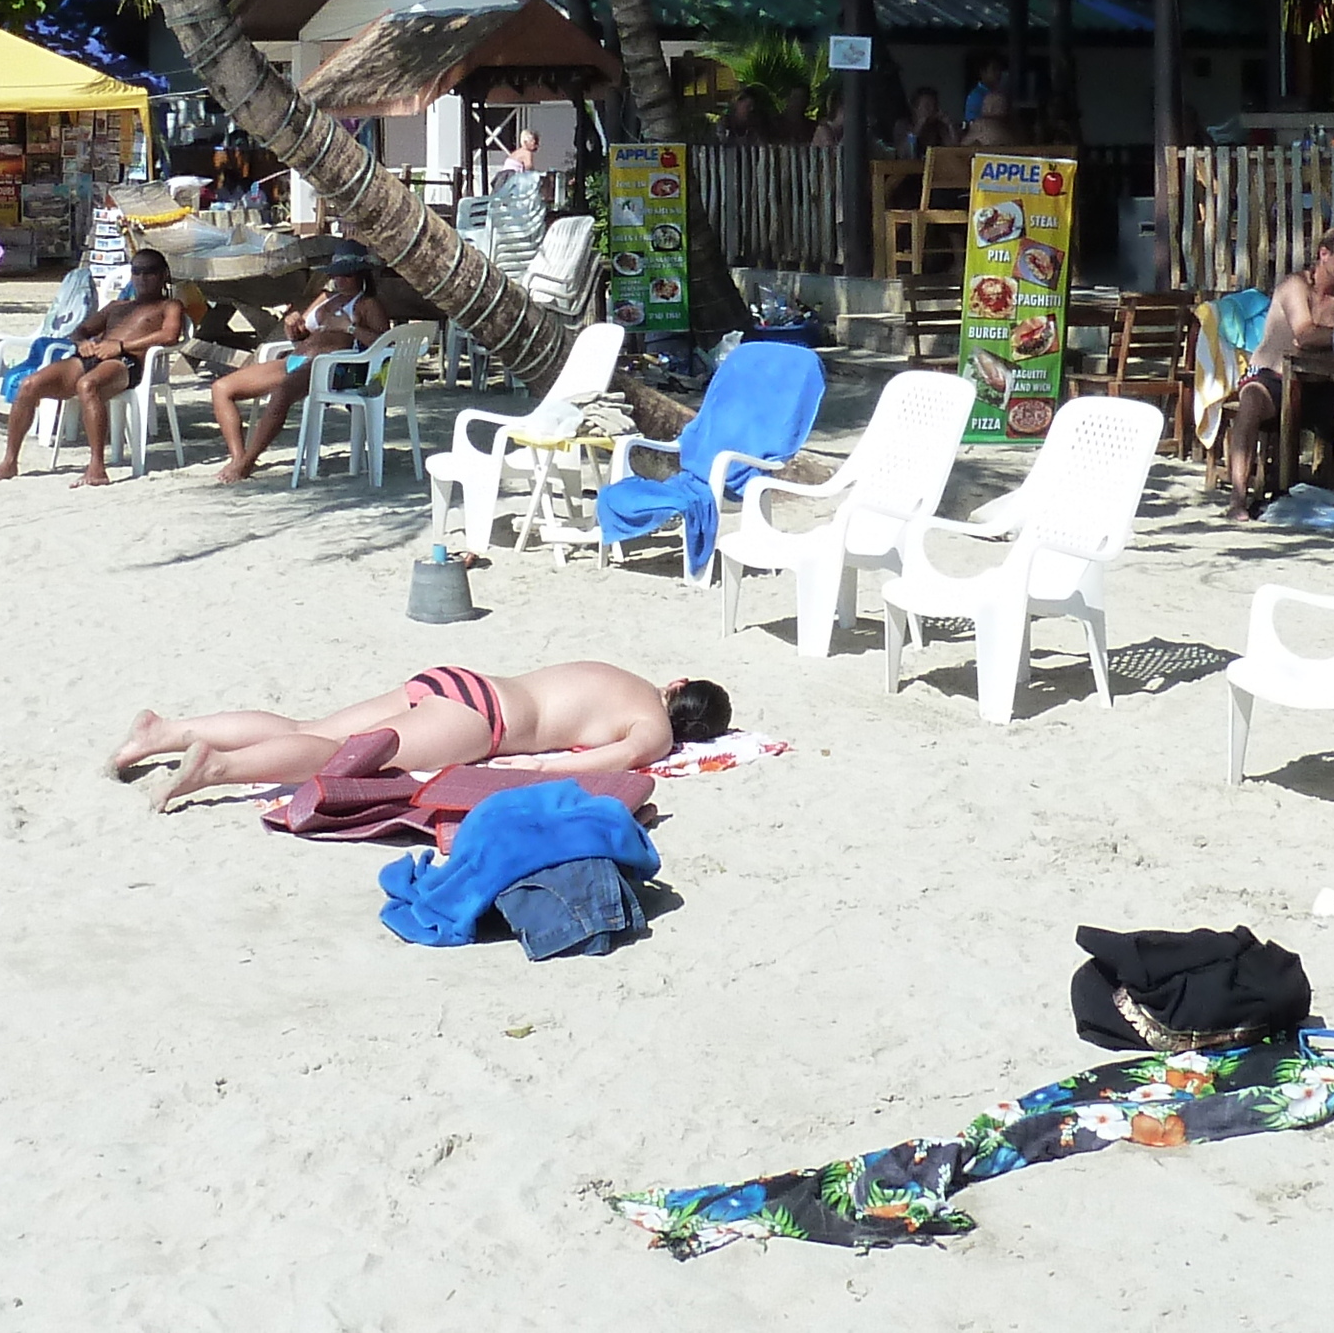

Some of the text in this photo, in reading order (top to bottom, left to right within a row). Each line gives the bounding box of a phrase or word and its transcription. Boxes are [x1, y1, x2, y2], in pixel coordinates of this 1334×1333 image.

[616, 148, 658, 161] APPLE
[980, 162, 1040, 183] APPLE
[987, 249, 1011, 263] PITA
[1012, 293, 1061, 307] SPAGHETTI
[968, 326, 1009, 339] BURGER
[971, 417, 1001, 430] PIZZA
